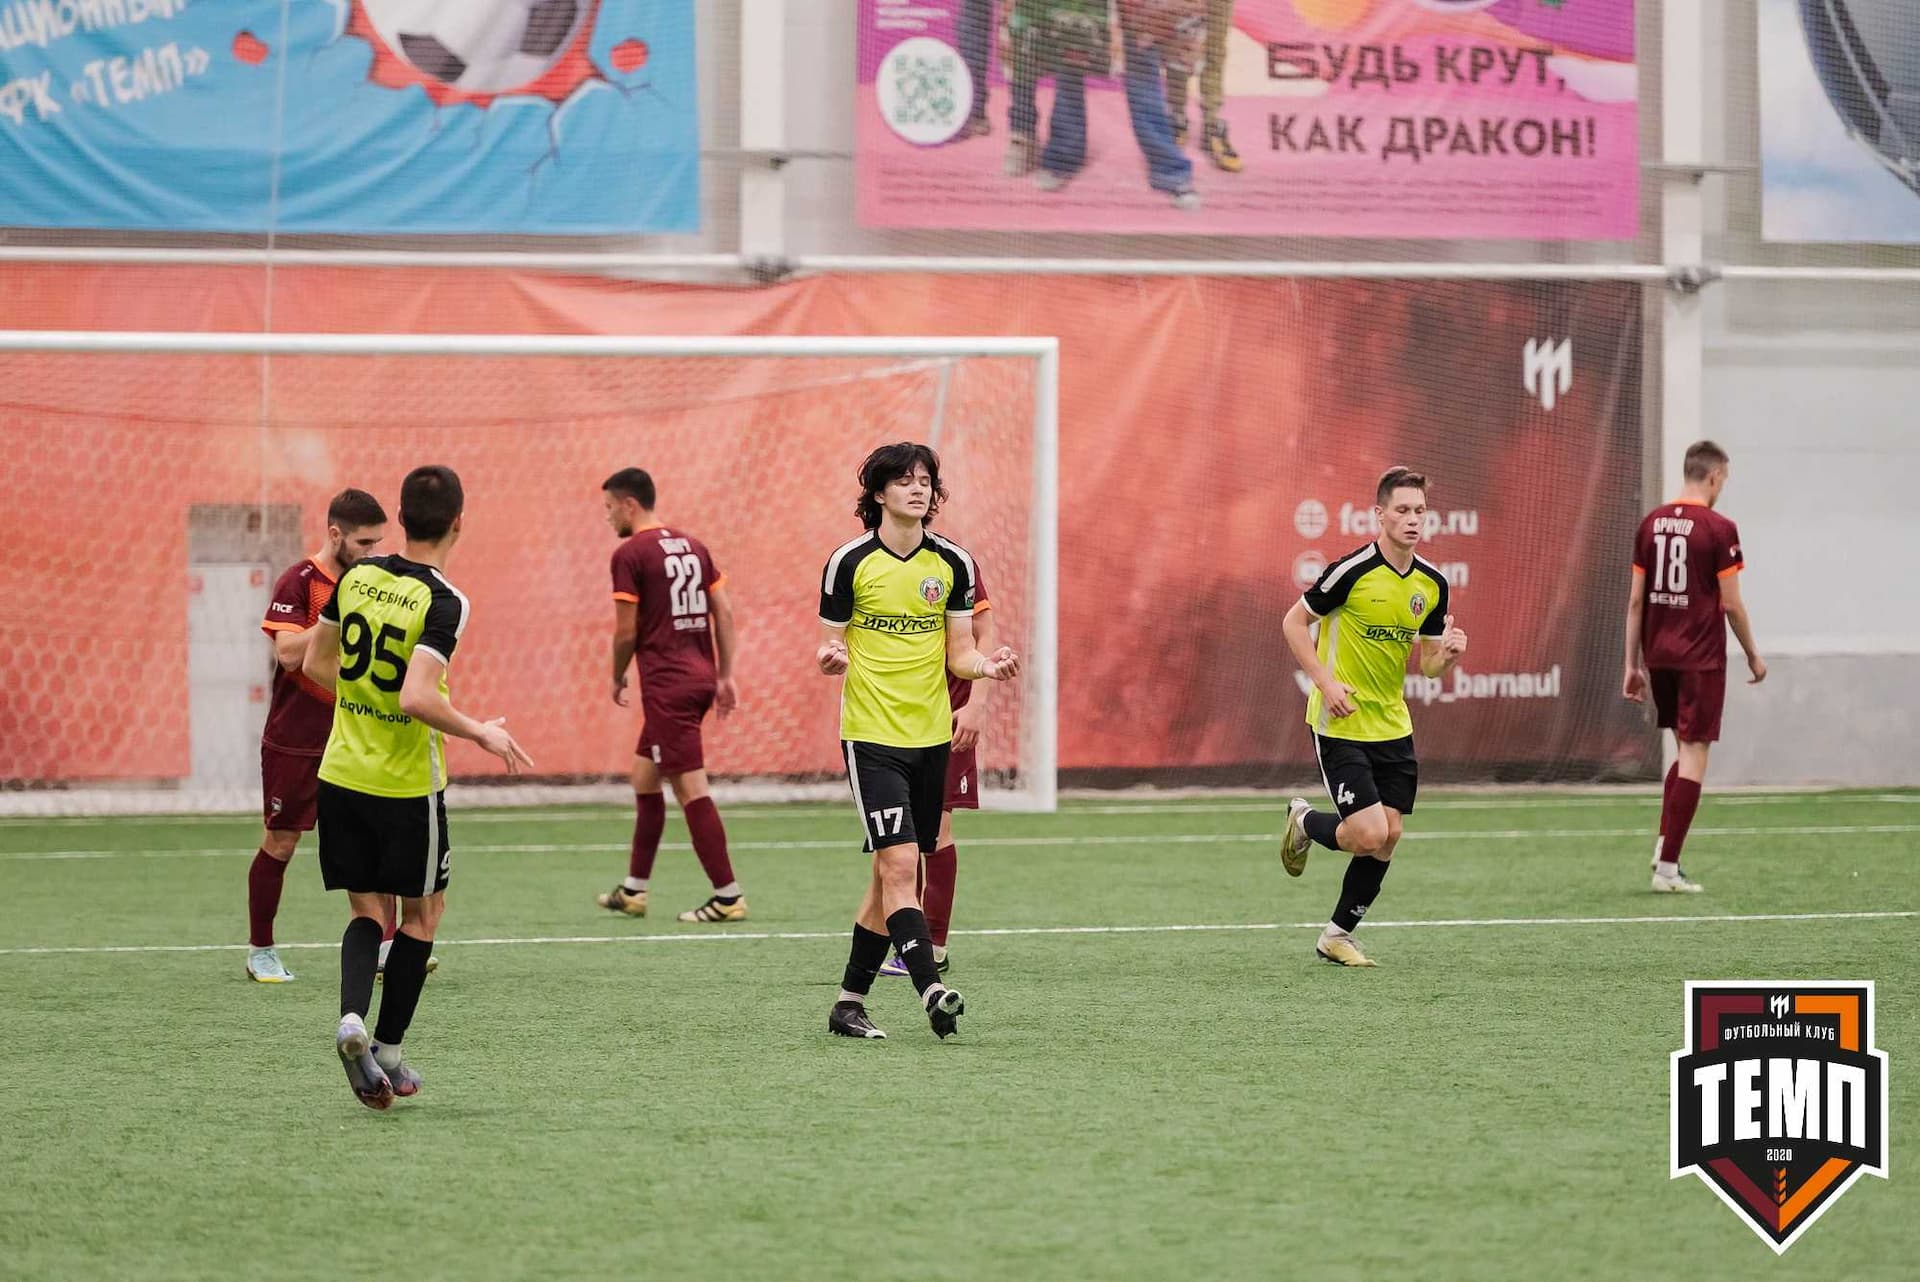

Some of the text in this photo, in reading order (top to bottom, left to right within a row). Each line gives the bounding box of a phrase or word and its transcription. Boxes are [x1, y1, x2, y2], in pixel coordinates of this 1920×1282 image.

[1268, 43, 1565, 92] БУДЬ КРУТ,
[1269, 113, 1596, 163] КАК ДРАКОН!
[664, 553, 708, 616] 22
[1654, 534, 1688, 593] 18
[339, 611, 408, 692] 95
[1337, 782, 1355, 805] 4
[870, 807, 904, 837] 17
